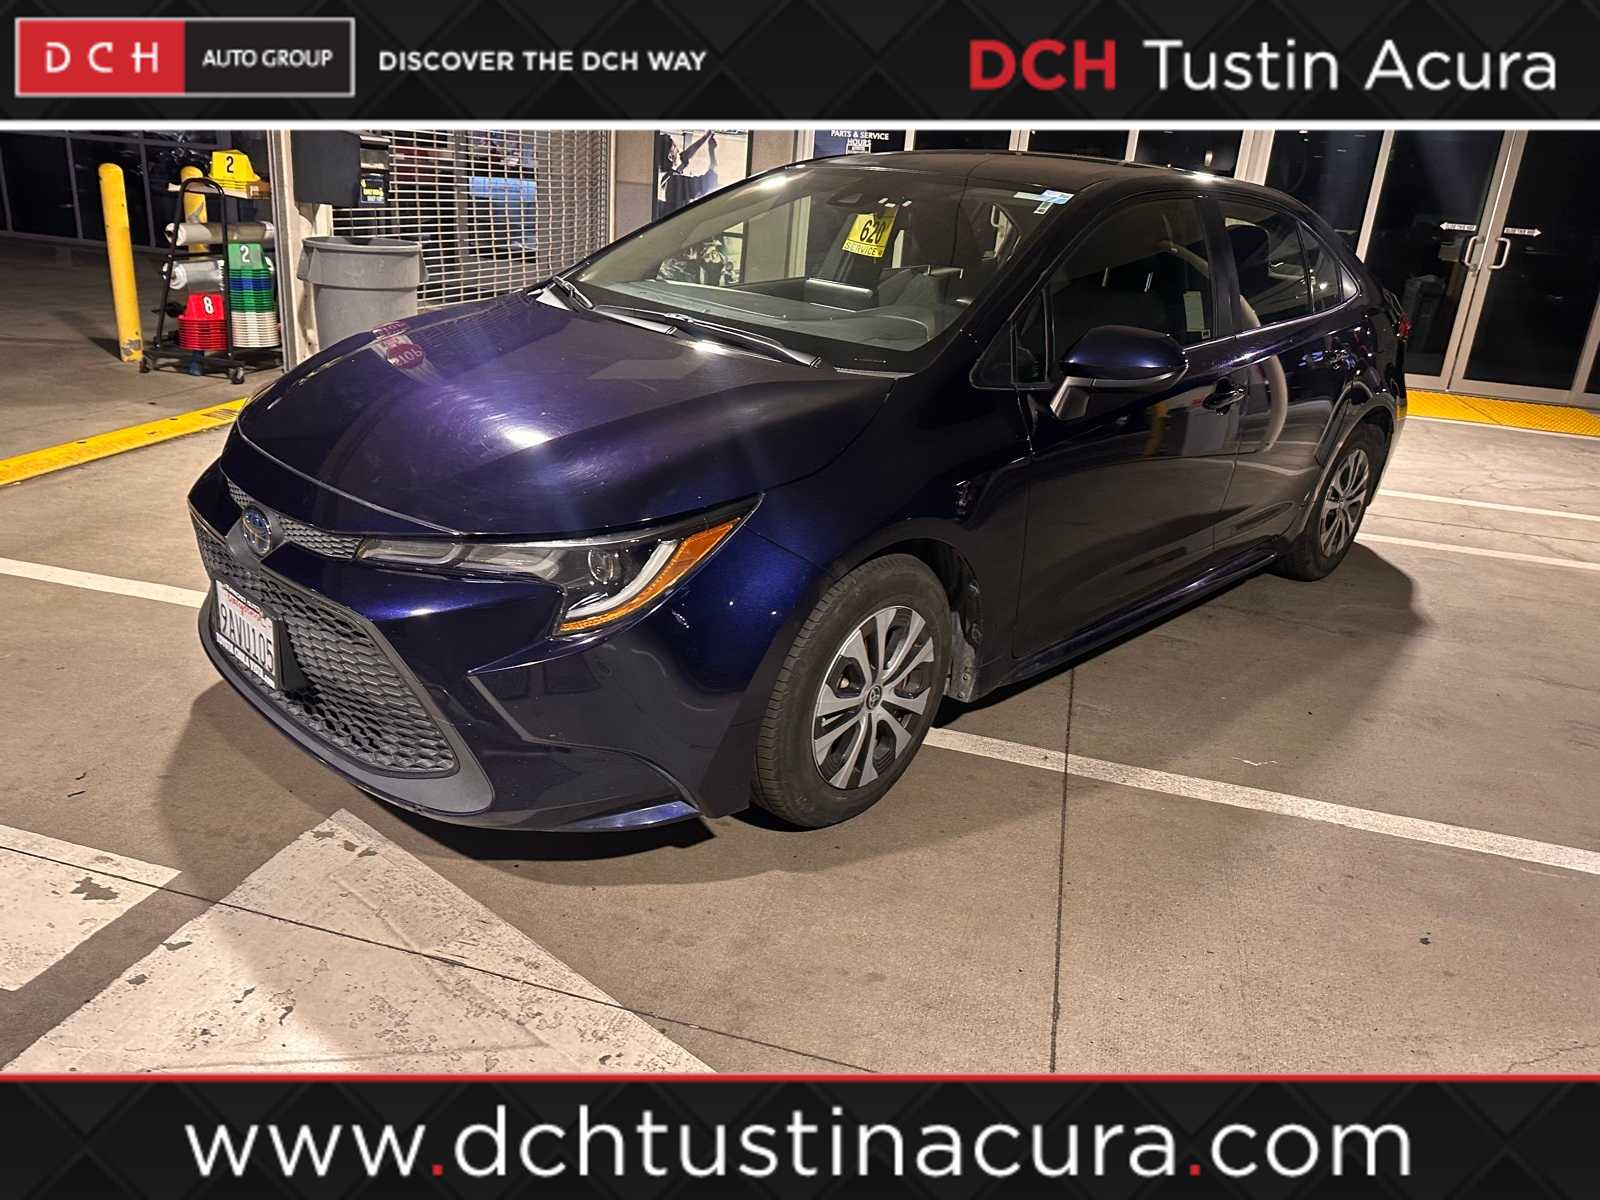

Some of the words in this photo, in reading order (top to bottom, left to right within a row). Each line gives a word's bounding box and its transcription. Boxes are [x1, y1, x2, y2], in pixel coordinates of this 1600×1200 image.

[830, 129, 851, 138] PARTS
[859, 131, 889, 141] SERVICE
[847, 138, 871, 147] HOURS
[226, 155, 234, 174] 2
[859, 219, 887, 245] 620
[239, 245, 250, 263] 2
[844, 241, 877, 256] SERVICE
[203, 296, 214, 315] 8
[220, 602, 274, 674] 9AVU105
